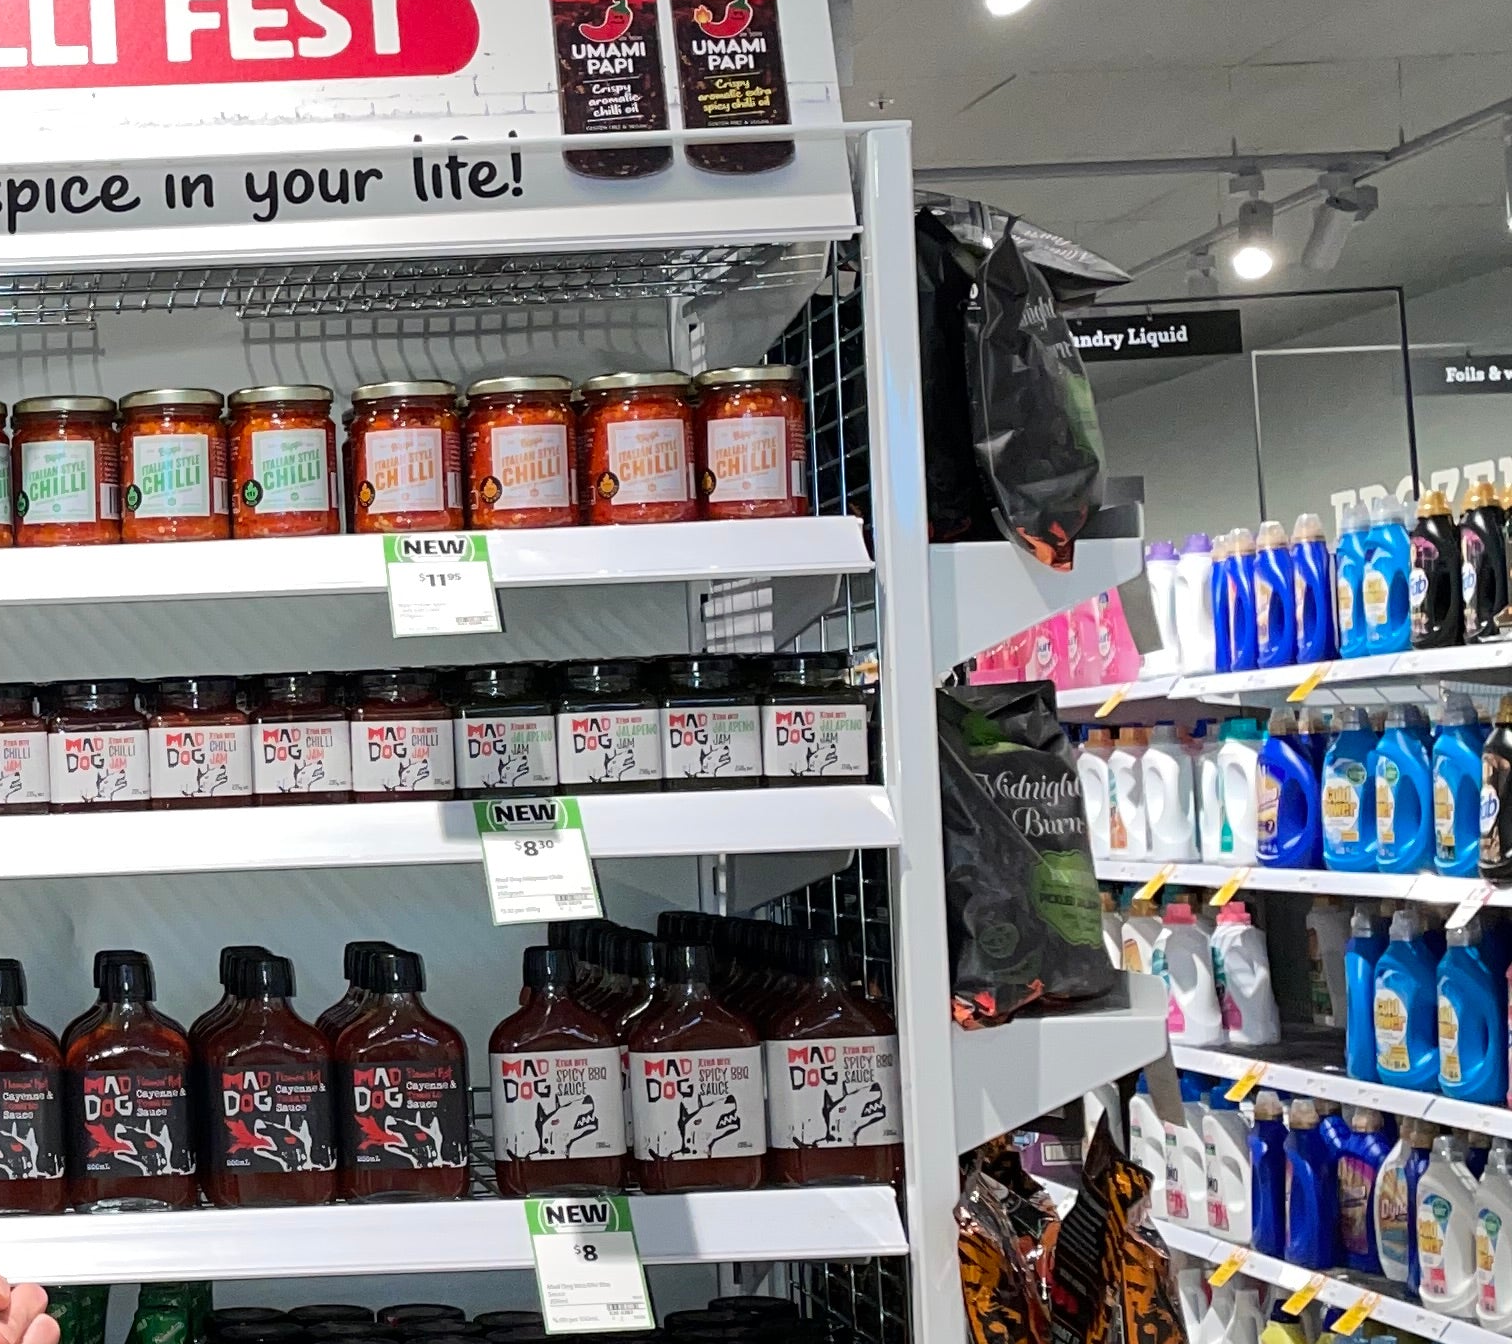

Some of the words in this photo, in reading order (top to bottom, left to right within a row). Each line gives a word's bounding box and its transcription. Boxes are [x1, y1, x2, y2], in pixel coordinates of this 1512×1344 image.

[571, 41, 646, 59] UMAMI
[691, 37, 767, 55] UMAMI
[587, 58, 634, 75] PAPI
[708, 54, 755, 71] PAPI
[591, 82, 631, 95] Crispy
[593, 104, 622, 117] chilli
[625, 103, 639, 113] oil
[166, 171, 216, 212] in
[244, 169, 383, 224] your
[412, 130, 525, 203] life!
[1128, 324, 1188, 348] Liquid
[1445, 367, 1485, 383] Foils
[1488, 366, 1502, 381] &
[27, 467, 58, 480] ITALIAN
[61, 460, 86, 474] STYLE
[263, 457, 294, 471] ITALIAN
[296, 451, 321, 464] STYLE
[263, 461, 321, 490] CHILLI
[29, 472, 86, 501] CHILLI
[403, 539, 465, 557] NEW
[775, 710, 815, 726] MAD
[776, 726, 815, 746] DOG
[819, 732, 839, 744] JAM
[4, 746, 31, 760] CHILLI
[3, 760, 22, 774] JAM
[494, 804, 556, 822] NEW
[1013, 806, 1084, 837] Burn
[501, 1058, 550, 1079] MAD
[555, 1068, 586, 1083] SPICY
[587, 1066, 607, 1081] BBQ
[644, 1058, 693, 1078] MAD
[699, 1067, 728, 1082] SPICY
[730, 1066, 749, 1080] BBQ
[353, 1067, 402, 1088] MAD
[406, 1080, 448, 1092] Cayenne
[449, 1080, 457, 1089] &
[503, 1078, 551, 1103] DOG
[556, 1081, 587, 1096] SAUCE
[646, 1078, 694, 1103] DOG
[699, 1080, 729, 1096] SAUCE
[354, 1087, 403, 1113] DOG
[406, 1099, 438, 1110] Sauce
[545, 1204, 607, 1224] NEW
[573, 1244, 598, 1262] $8
